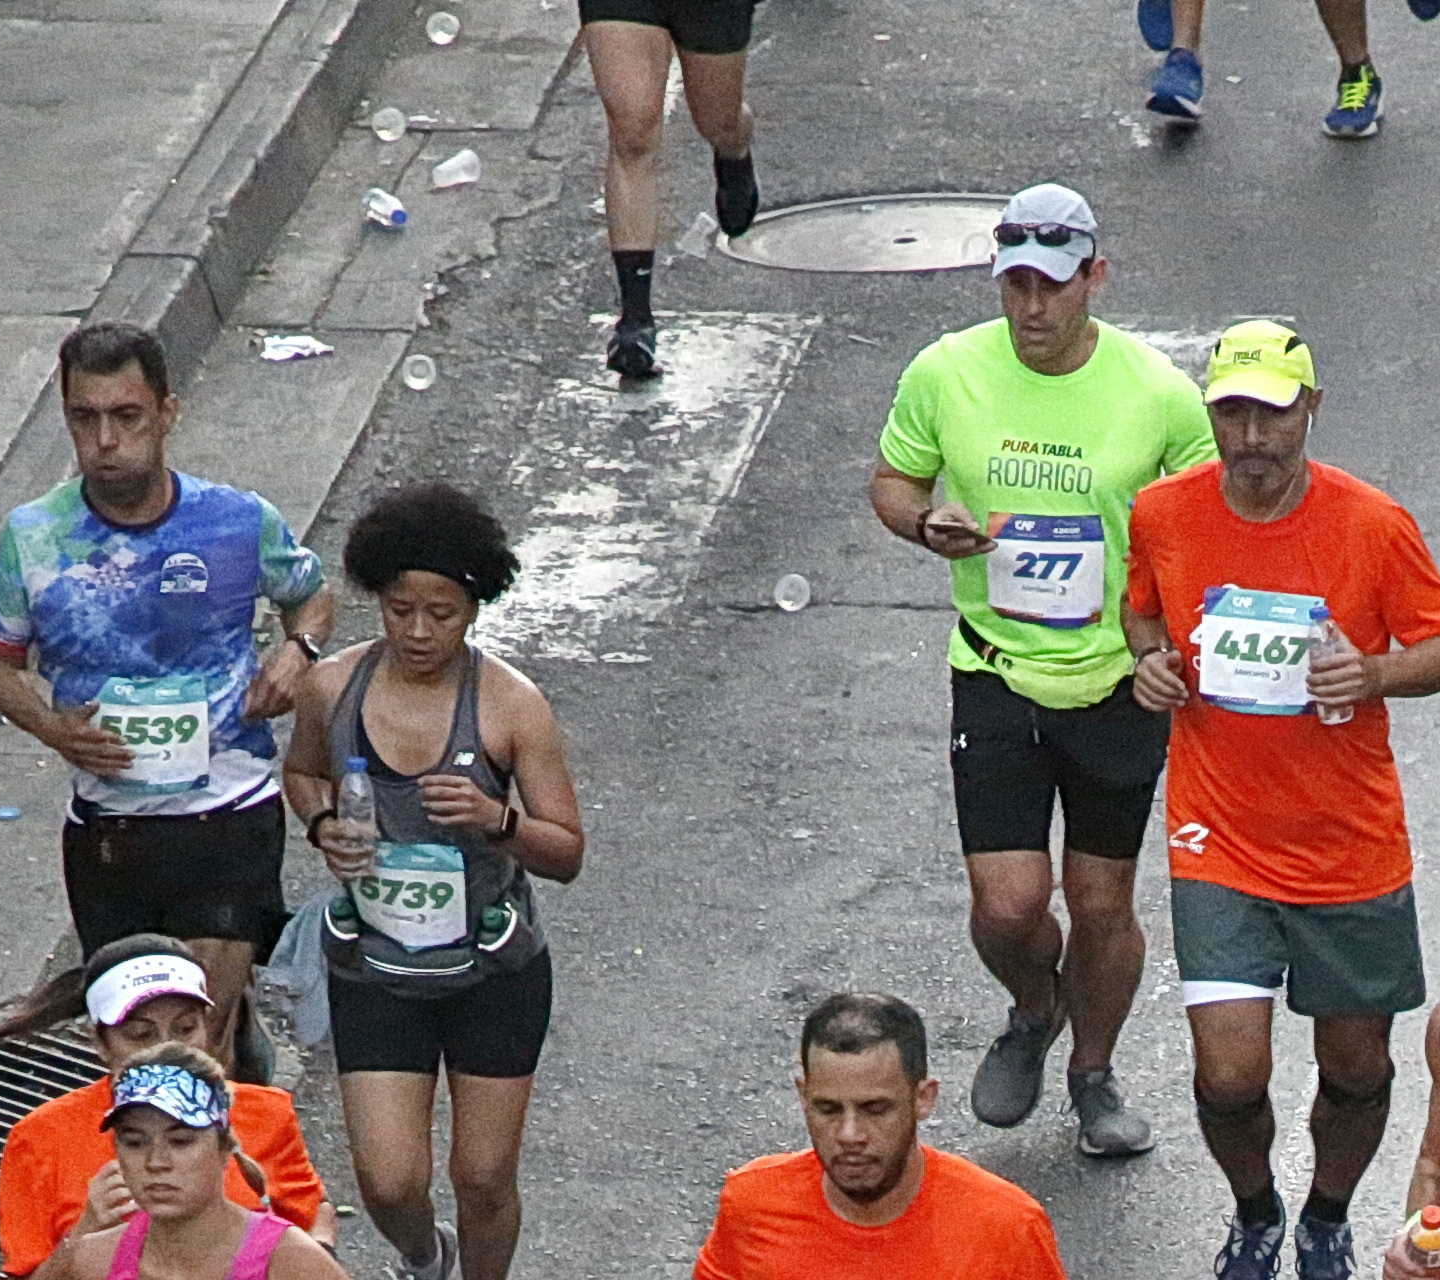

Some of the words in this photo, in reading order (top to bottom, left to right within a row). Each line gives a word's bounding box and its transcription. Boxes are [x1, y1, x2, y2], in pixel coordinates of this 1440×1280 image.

[1000, 439, 1039, 455] PURA
[1041, 441, 1083, 461] TABLA
[987, 455, 1093, 496] RODRIGO
[1012, 551, 1085, 581] 277
[1213, 629, 1318, 667] 4167
[100, 713, 199, 746] 5539
[359, 873, 454, 910] 5739
